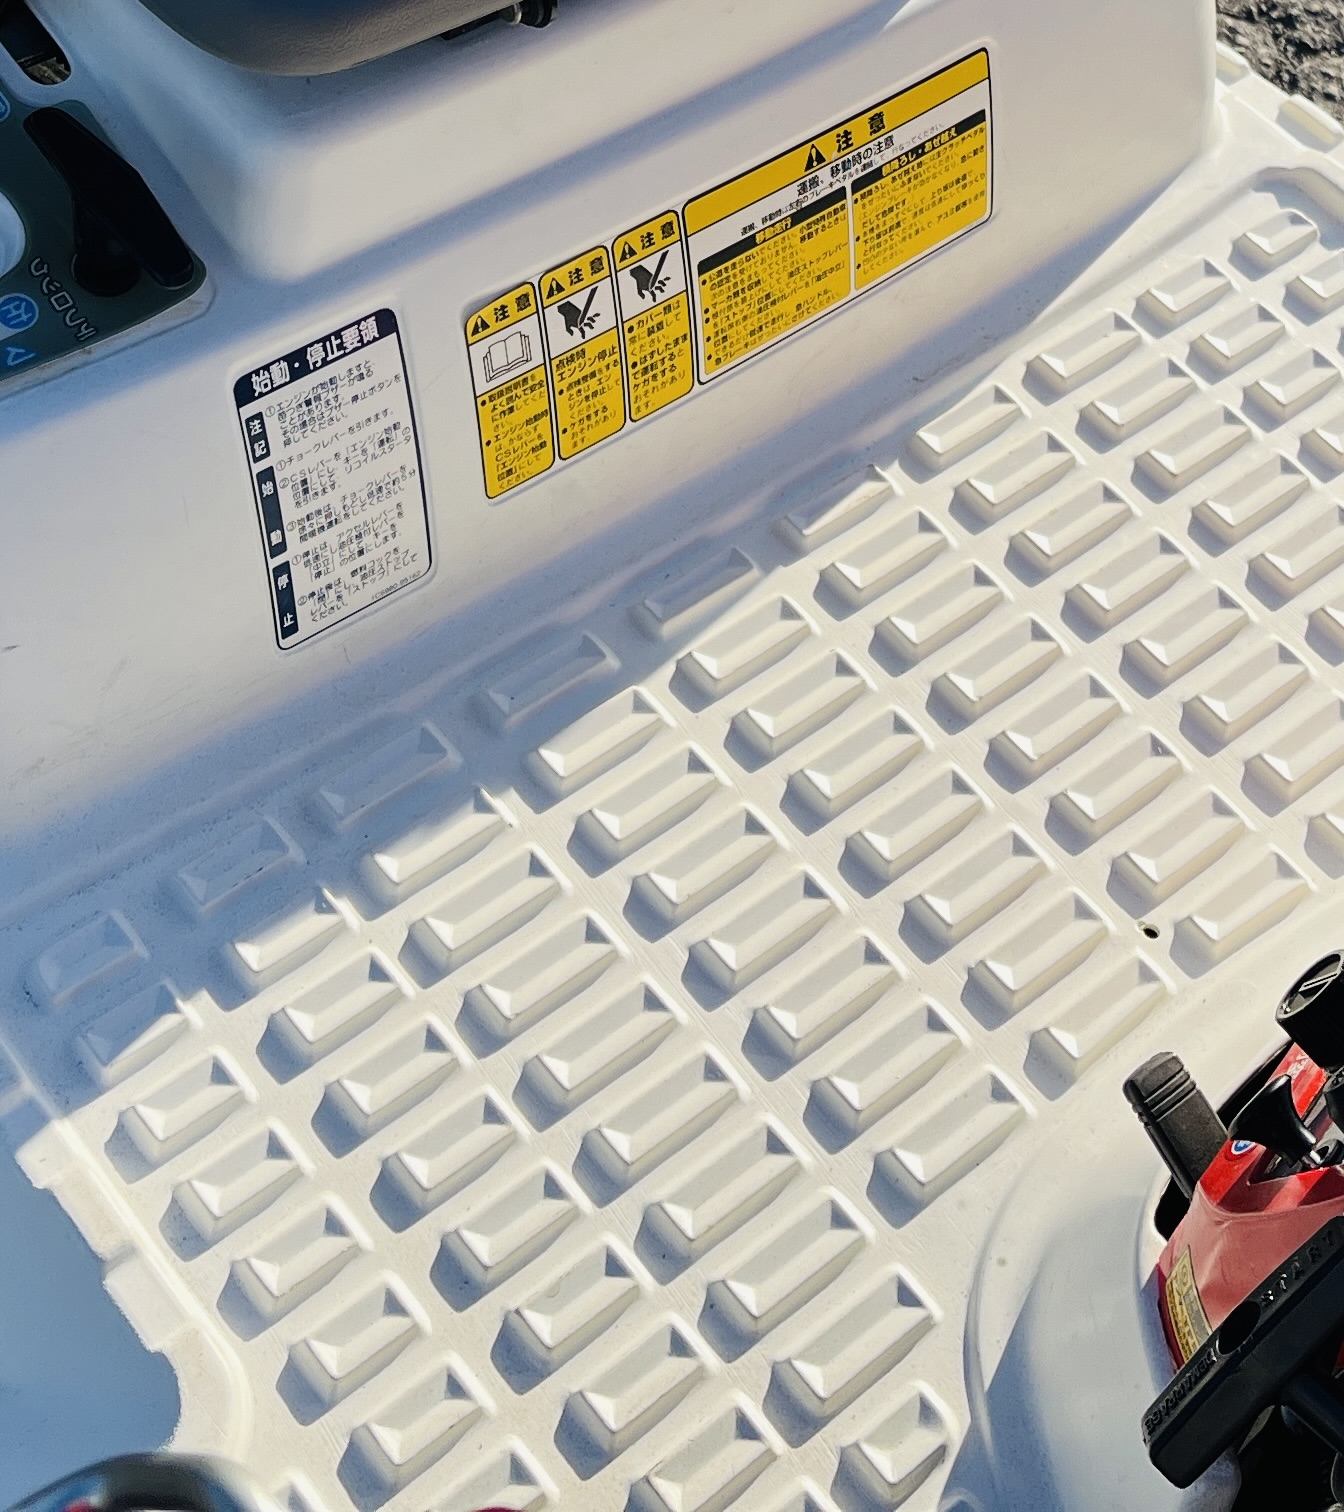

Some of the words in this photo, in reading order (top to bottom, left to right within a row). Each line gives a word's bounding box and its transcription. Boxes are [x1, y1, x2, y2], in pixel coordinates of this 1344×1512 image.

[836, 108, 885, 154] 注意
[640, 219, 674, 251] 注意
[568, 254, 604, 287] 注意
[0, 301, 32, 326] 左
[29, 257, 97, 341] デフロック
[493, 290, 531, 324] 注意
[250, 314, 379, 398] 始動・停止要領
[248, 416, 267, 458] 注記
